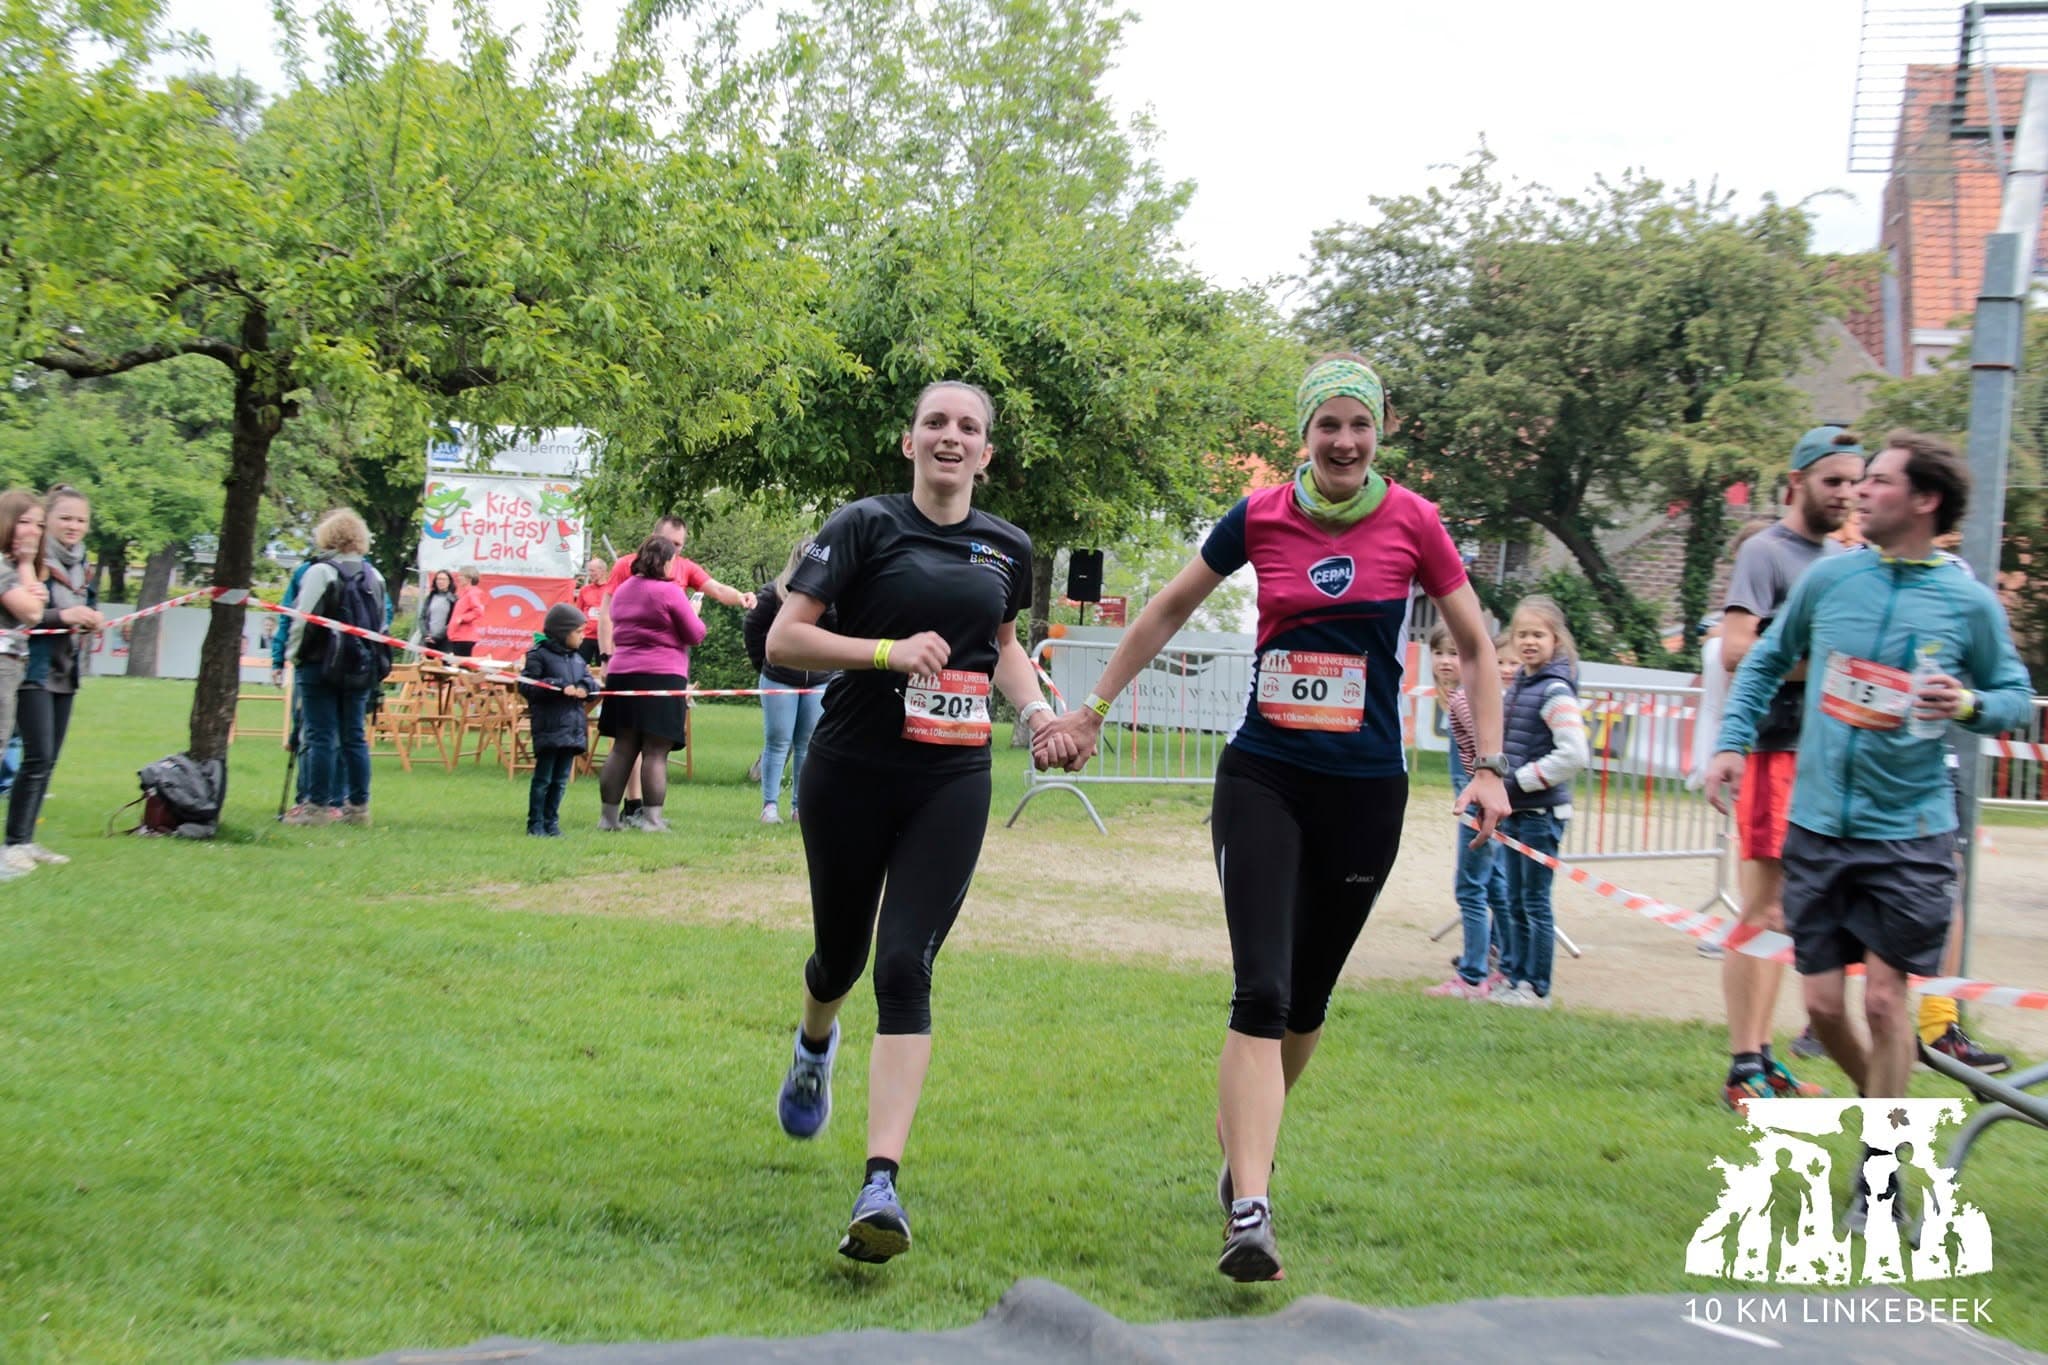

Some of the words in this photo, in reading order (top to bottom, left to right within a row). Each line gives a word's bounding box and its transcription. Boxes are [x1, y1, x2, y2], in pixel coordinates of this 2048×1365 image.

[486, 491, 533, 519] Kids
[460, 511, 550, 544] Fantasy
[474, 537, 530, 561] Land
[1263, 682, 1280, 693] iris
[1292, 678, 1328, 701] 60
[929, 694, 973, 719] 203
